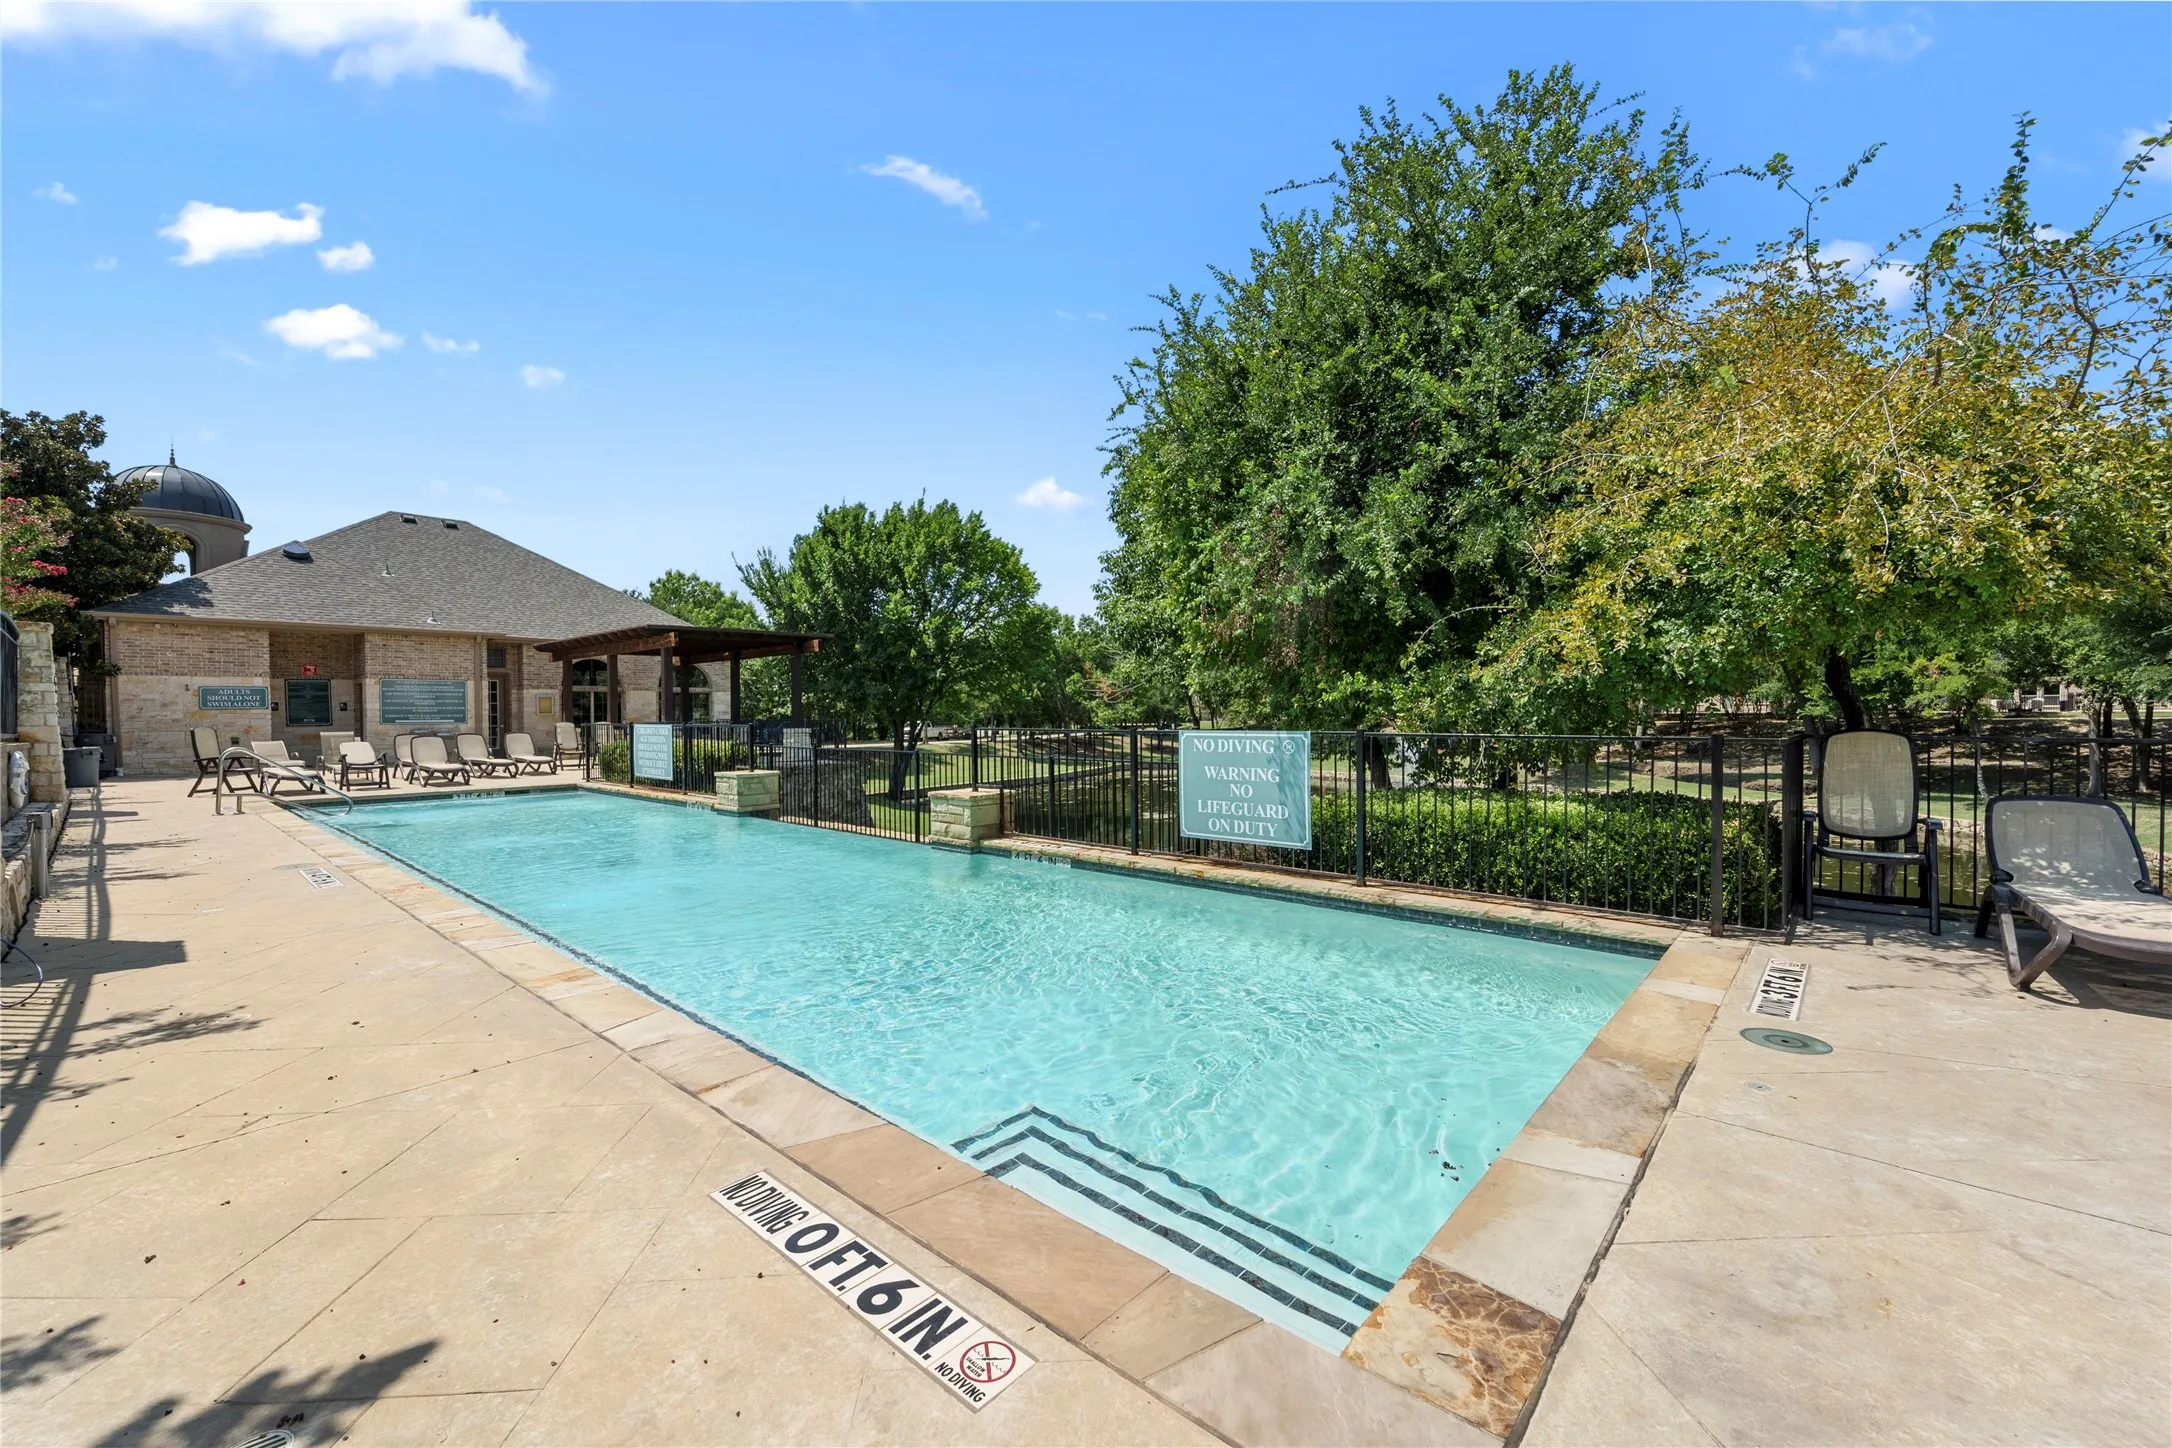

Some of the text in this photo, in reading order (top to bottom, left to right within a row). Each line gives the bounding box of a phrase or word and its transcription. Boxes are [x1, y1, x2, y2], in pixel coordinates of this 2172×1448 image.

[1193, 739, 1275, 754] NO DIVING
[1203, 766, 1280, 783] WARNING
[1229, 784, 1253, 798] NO
[1197, 800, 1289, 819] LIFEGUARD
[1208, 818, 1279, 837] ON DUTY
[719, 1174, 809, 1234] NO DIVING
[808, 1239, 889, 1292] FT.
[856, 1279, 921, 1315] 6
[888, 1297, 969, 1361] IN.
[965, 1356, 986, 1373] SHALLOW
[966, 1365, 983, 1378] WATER
[934, 1361, 986, 1403] NO DIVING
